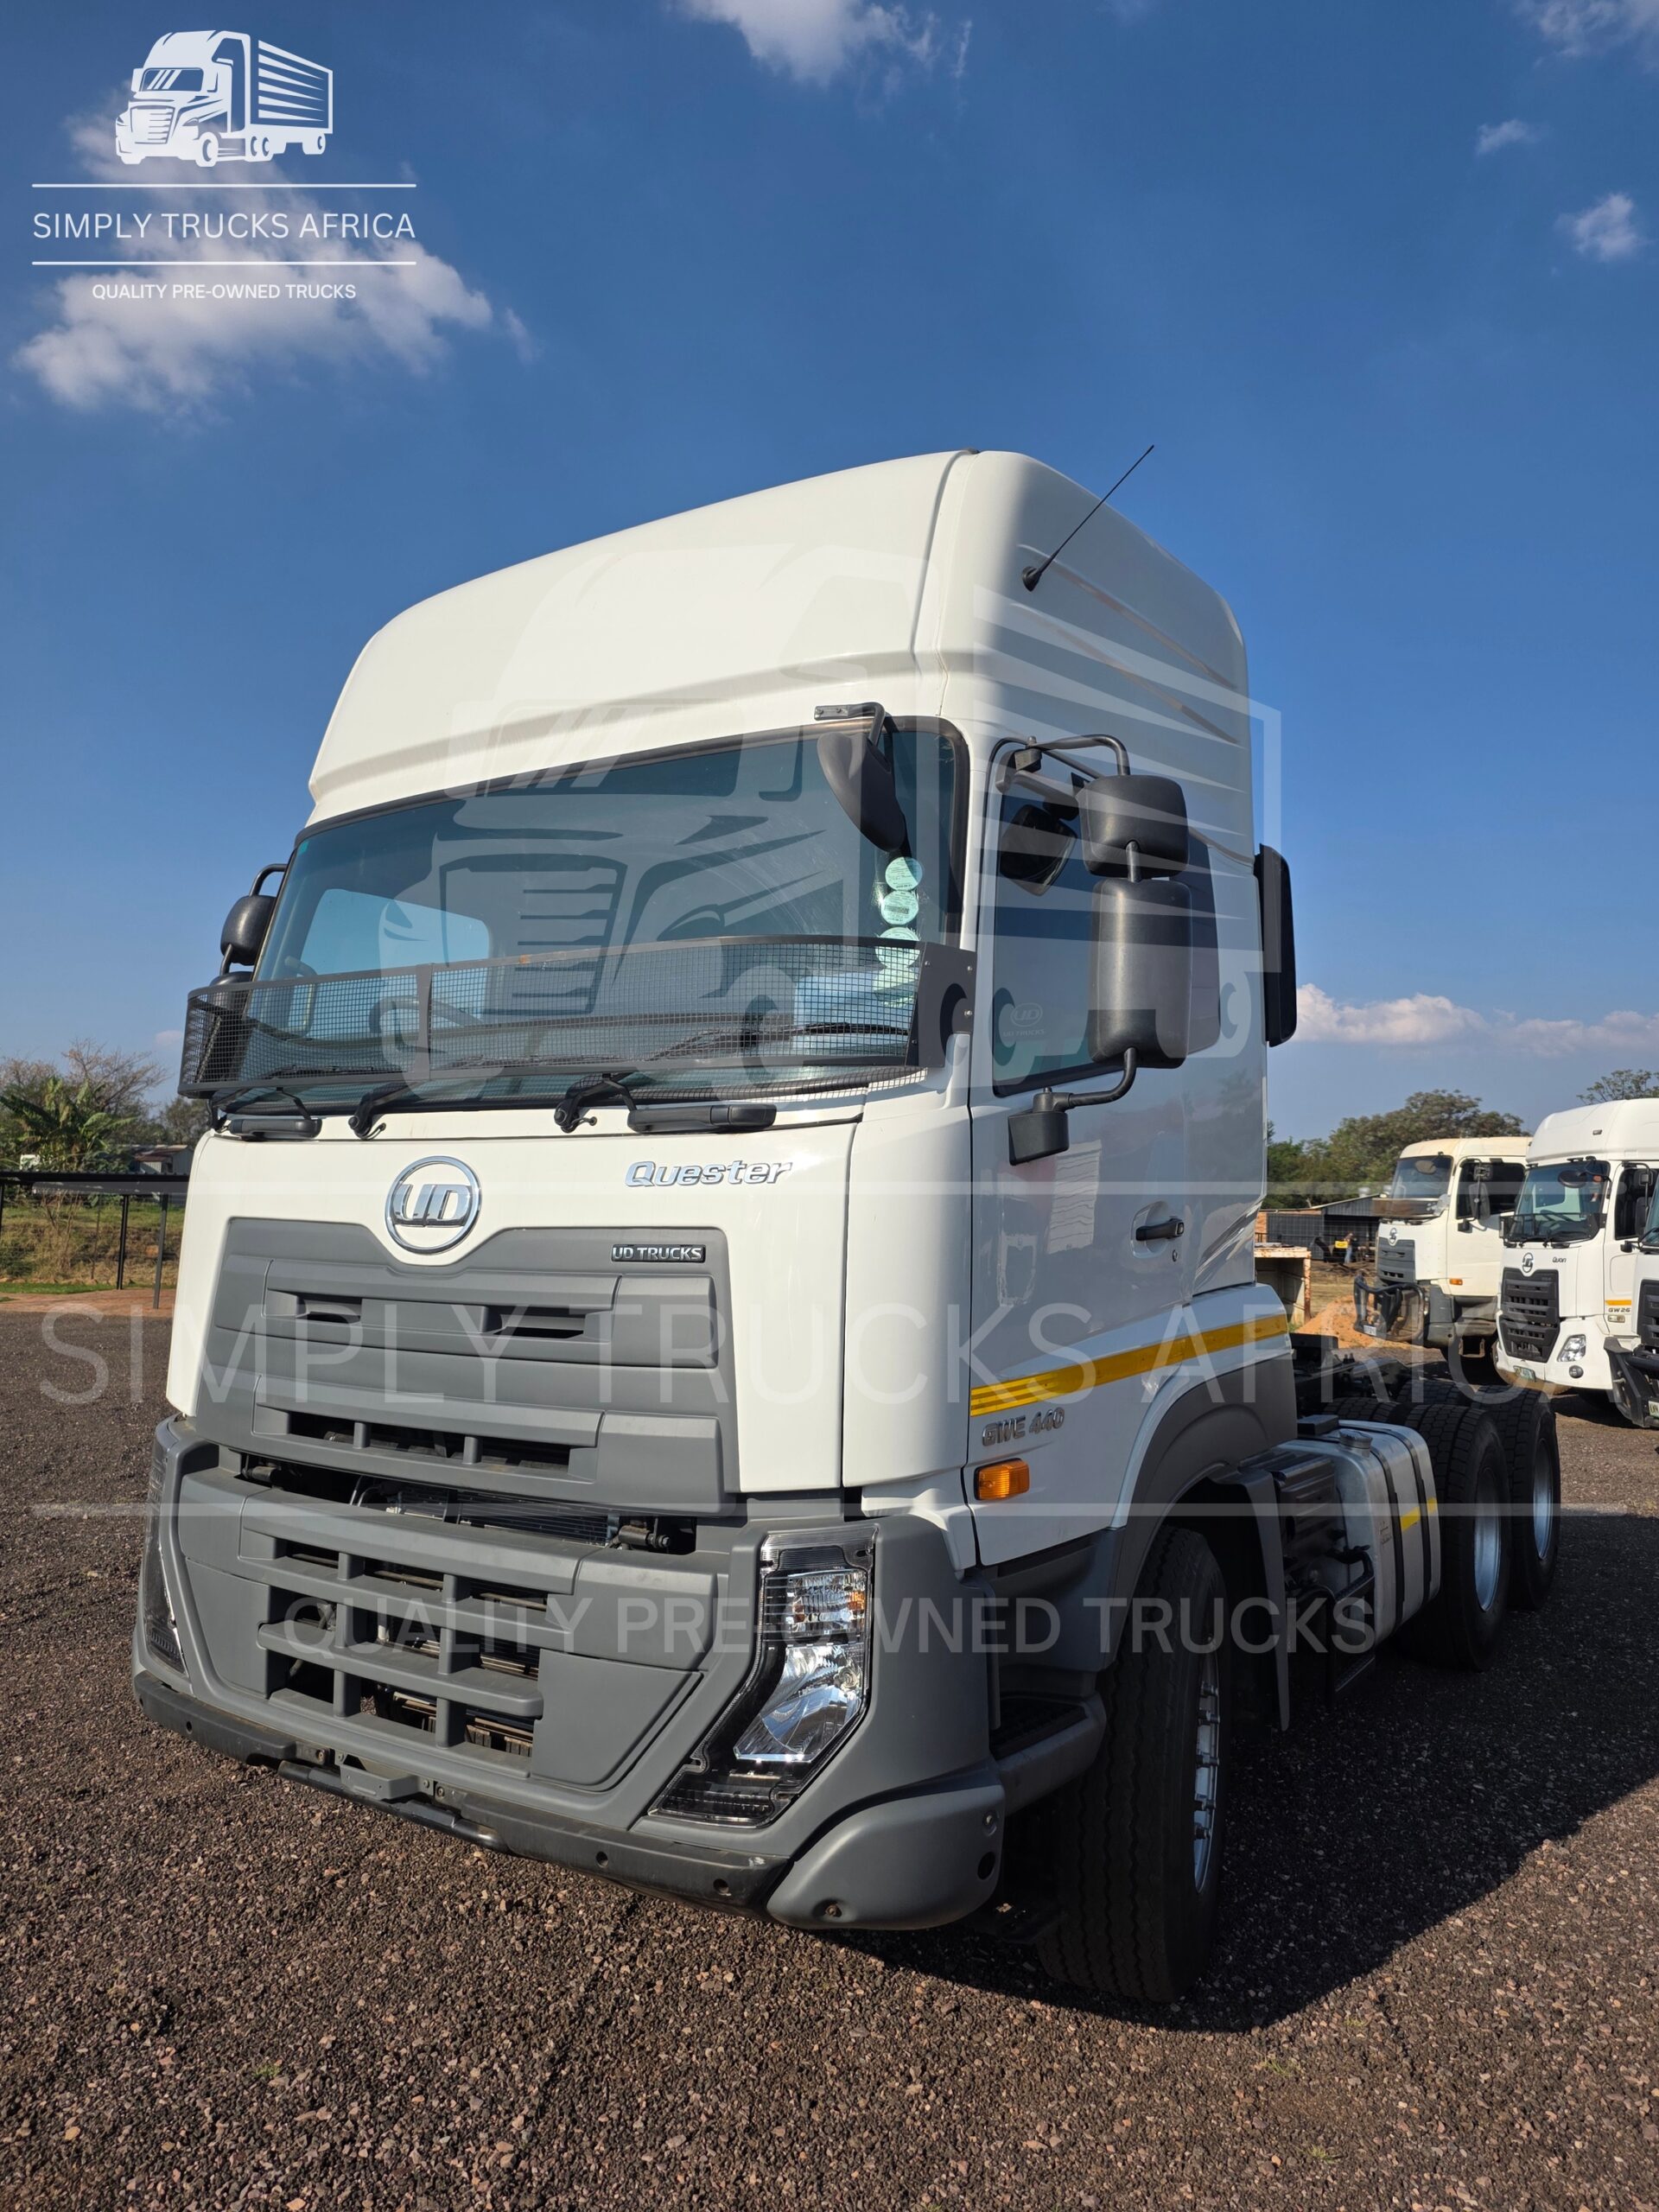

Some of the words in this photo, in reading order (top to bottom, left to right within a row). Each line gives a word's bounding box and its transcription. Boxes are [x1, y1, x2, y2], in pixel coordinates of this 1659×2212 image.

[625, 1159, 793, 1188] Quester
[394, 1184, 472, 1228] UD
[613, 1247, 634, 1259] UD
[637, 1247, 702, 1260] TRUCKS
[982, 1415, 1027, 1446] GWE
[1028, 1407, 1065, 1434] 440
